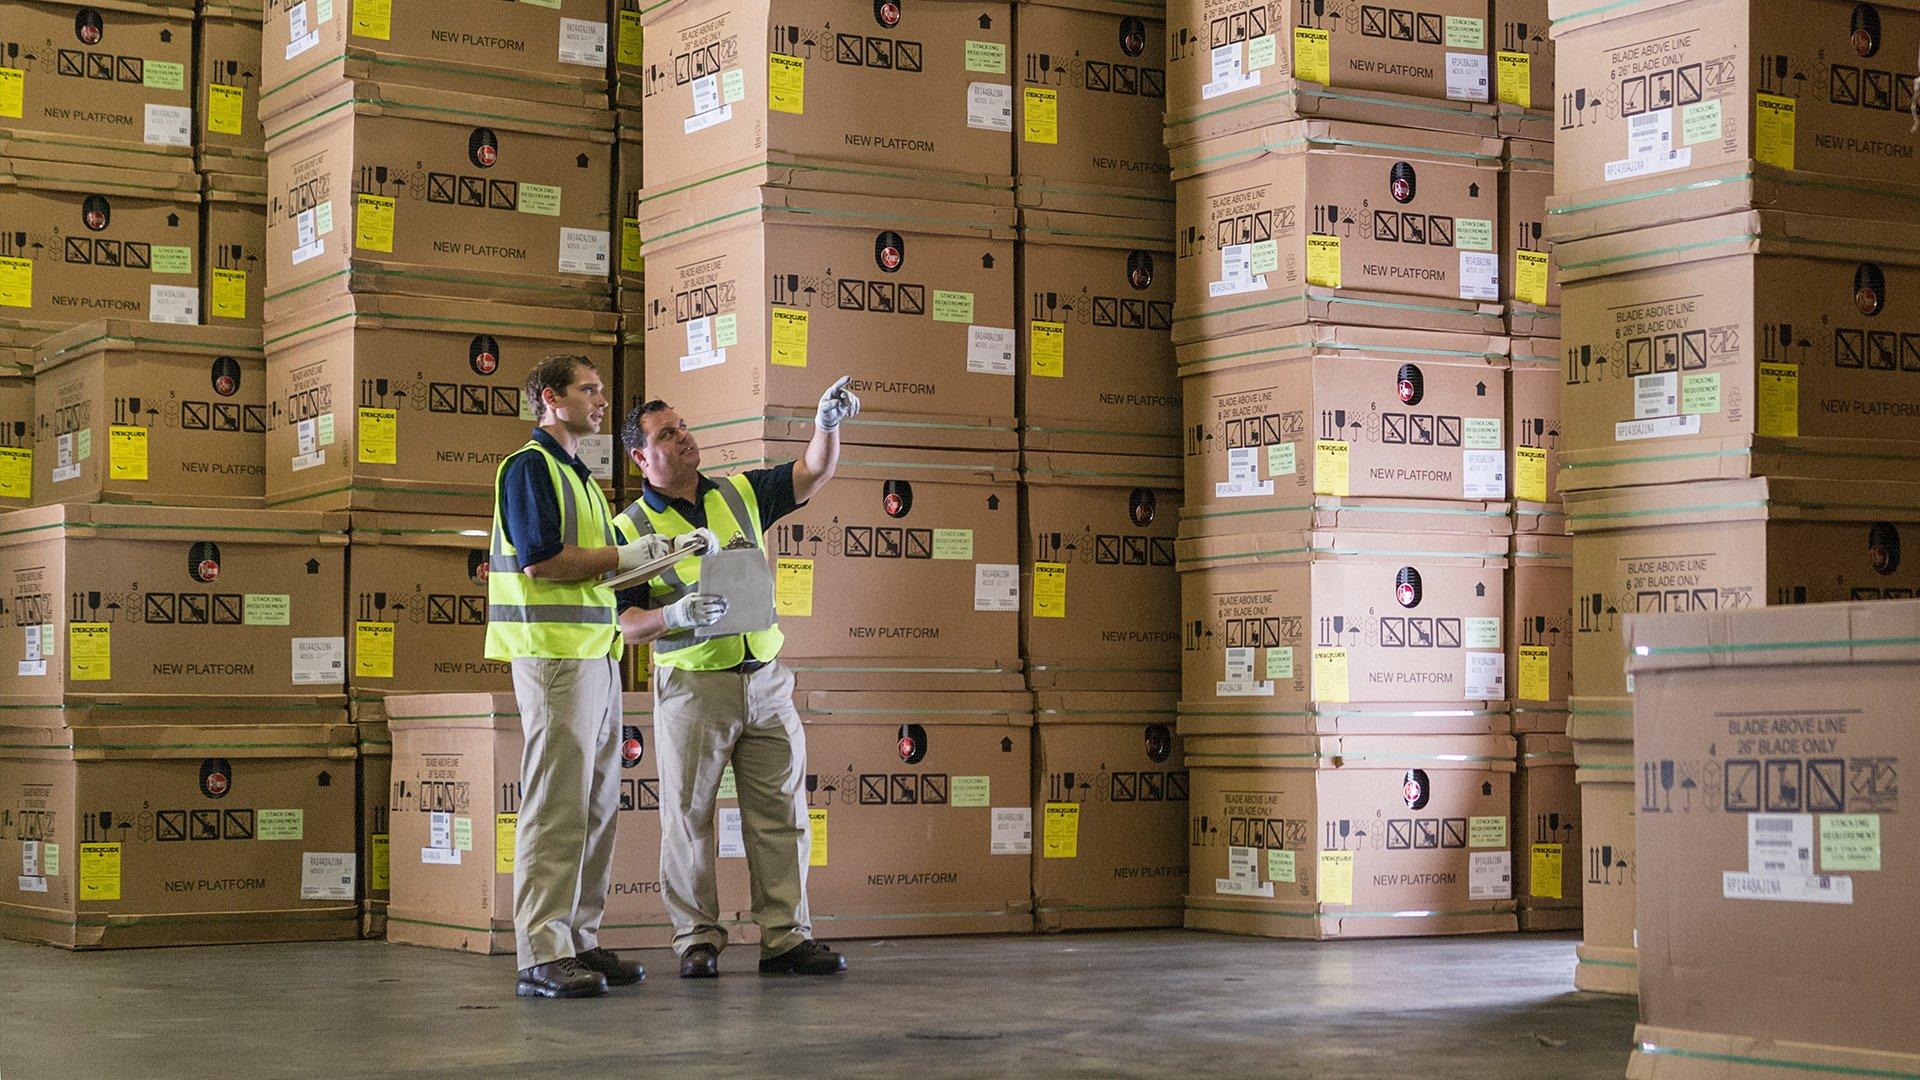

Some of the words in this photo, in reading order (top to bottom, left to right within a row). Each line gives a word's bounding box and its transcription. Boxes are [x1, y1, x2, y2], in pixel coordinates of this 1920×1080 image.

[1452, 18, 1477, 26] STACKING
[1448, 26, 1481, 34] REQUIREMENT
[431, 30, 461, 44] NEW
[464, 34, 524, 51] PLATFORM
[1296, 32, 1328, 41] ENERGYGUIDE
[972, 42, 999, 51] STACKING
[1612, 50, 1639, 64] BLADE
[1641, 42, 1669, 56] ABOVE
[1671, 36, 1691, 49] LINE
[967, 50, 1004, 59] REQUIREMENT
[1349, 60, 1375, 72] NEW
[1378, 63, 1434, 79] PLATFORM
[1633, 60, 1658, 74] BLADE
[1662, 53, 1684, 67] ONLY
[1689, 103, 1715, 114] STACKING
[44, 107, 69, 120] NEW
[73, 109, 133, 125] PLATFORM
[845, 135, 872, 147] NEW
[874, 137, 934, 152] PLATFORM
[1815, 133, 1844, 148] NEW
[1847, 138, 1912, 157] PLATFORM
[1092, 157, 1117, 169] NEW
[1120, 159, 1168, 174] PLATFOR
[1213, 196, 1233, 208] BLADE
[1233, 193, 1250, 205] ABOVE
[1251, 190, 1266, 201] LINE
[1363, 199, 1369, 207] 6
[1226, 206, 1244, 218] BLADE
[1245, 202, 1261, 214] ONLY
[1462, 221, 1487, 229] STACKING
[1457, 228, 1490, 236] REQUIREMENT
[1308, 240, 1339, 248] ENERGYGUIDE
[434, 242, 461, 255] NEW
[464, 244, 526, 259] PLATFORM
[1363, 264, 1389, 276] NEW
[1392, 266, 1445, 281] PLATFORM
[52, 294, 79, 307] NEW
[82, 297, 141, 311] PLATFORM
[1616, 310, 1643, 323] BLADE
[1645, 305, 1672, 319] ABOVE
[1675, 301, 1695, 314] LINE
[1637, 321, 1662, 334] BLADE
[1665, 317, 1689, 331] ONLY
[1689, 377, 1714, 385] STACKING
[875, 382, 935, 395] PLATFORM
[1100, 393, 1124, 404] NEW
[1218, 396, 1240, 408] BLADE
[1240, 393, 1257, 404] ABOVE
[1258, 392, 1273, 401] LINE
[1233, 406, 1251, 417] BLADE
[1252, 404, 1268, 415] ONLY
[1370, 402, 1376, 410] 6
[1821, 400, 1850, 413] NEW
[1318, 445, 1348, 453] ENERGYGUIDE
[437, 451, 463, 462] NEW
[181, 462, 209, 473] NEW
[212, 463, 265, 476] PLATFOR
[1370, 468, 1395, 479] NEW
[1398, 470, 1452, 482] PLATFORM
[1628, 561, 1654, 575] BLADE
[1657, 560, 1684, 573] ABOVE
[1686, 559, 1707, 571] LINE
[1648, 575, 1673, 588] BLADE
[1676, 574, 1700, 586] ONLY
[1219, 595, 1239, 606] BLADE
[1240, 595, 1256, 605] ABOVE
[1258, 594, 1273, 604] LINE
[1233, 607, 1251, 617] BLADE
[1252, 605, 1268, 615] ONLY
[1369, 607, 1374, 615] 6
[849, 627, 875, 638] NEW
[878, 628, 939, 639] PLATFORM
[1102, 631, 1127, 641] NEW
[1130, 632, 1180, 643] PLATFOR
[153, 664, 182, 675] NEW
[186, 664, 254, 675] PLATFORM
[434, 663, 461, 673] NEW
[465, 662, 512, 674] PLATFO
[1369, 672, 1394, 682] NEW
[1396, 672, 1453, 683] PLATFORM
[1729, 719, 1768, 735] BLADE
[1772, 718, 1813, 735] ABOVE
[1817, 718, 1846, 733] LINE
[1710, 744, 1715, 756] 4
[1759, 739, 1798, 754] BLADE
[1802, 738, 1836, 754] ONLY
[1225, 795, 1244, 805] BLADE
[1245, 795, 1261, 805] ABOVE
[1263, 795, 1278, 805] LINE
[1238, 805, 1255, 816] BLADE
[1257, 806, 1273, 816] ONLY
[1376, 809, 1381, 817] 6
[1114, 867, 1139, 878] NEW
[165, 881, 194, 891] NEW
[198, 878, 266, 891] PLATFORM
[868, 874, 895, 885] NEW
[898, 873, 957, 885] PLATFORM
[1374, 875, 1399, 885] NEW
[1402, 874, 1455, 885] PLATFORM
[615, 882, 660, 895] PLATFO
